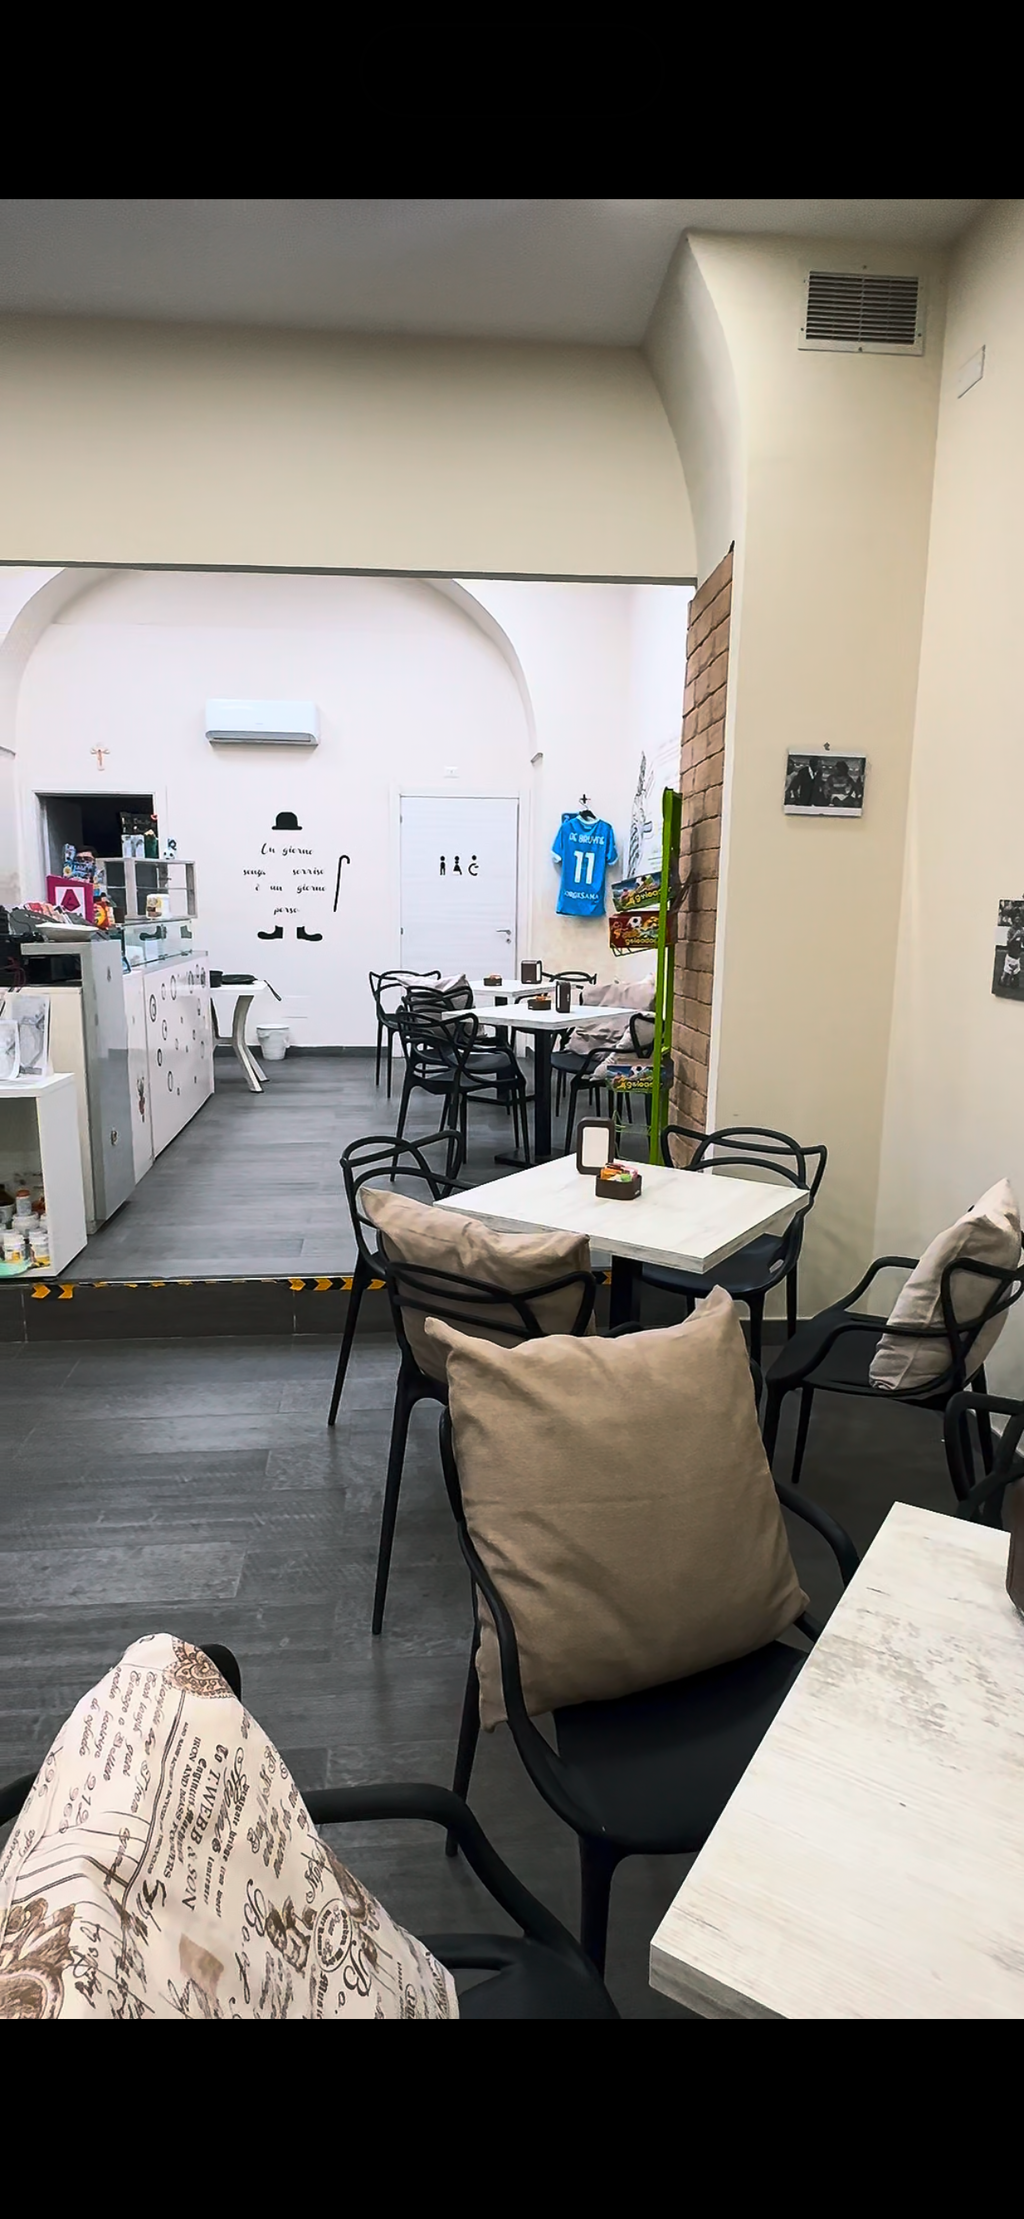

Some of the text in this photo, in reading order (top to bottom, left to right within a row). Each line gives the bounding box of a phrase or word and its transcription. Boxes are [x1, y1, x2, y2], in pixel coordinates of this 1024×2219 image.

[282, 846, 313, 856] giorno
[292, 867, 324, 875] sorriso
[574, 851, 595, 884] 11
[297, 884, 326, 894] giorno
[186, 1735, 201, 1763] IRON
[179, 1763, 191, 1787] AND
[180, 1863, 199, 1911] SON
